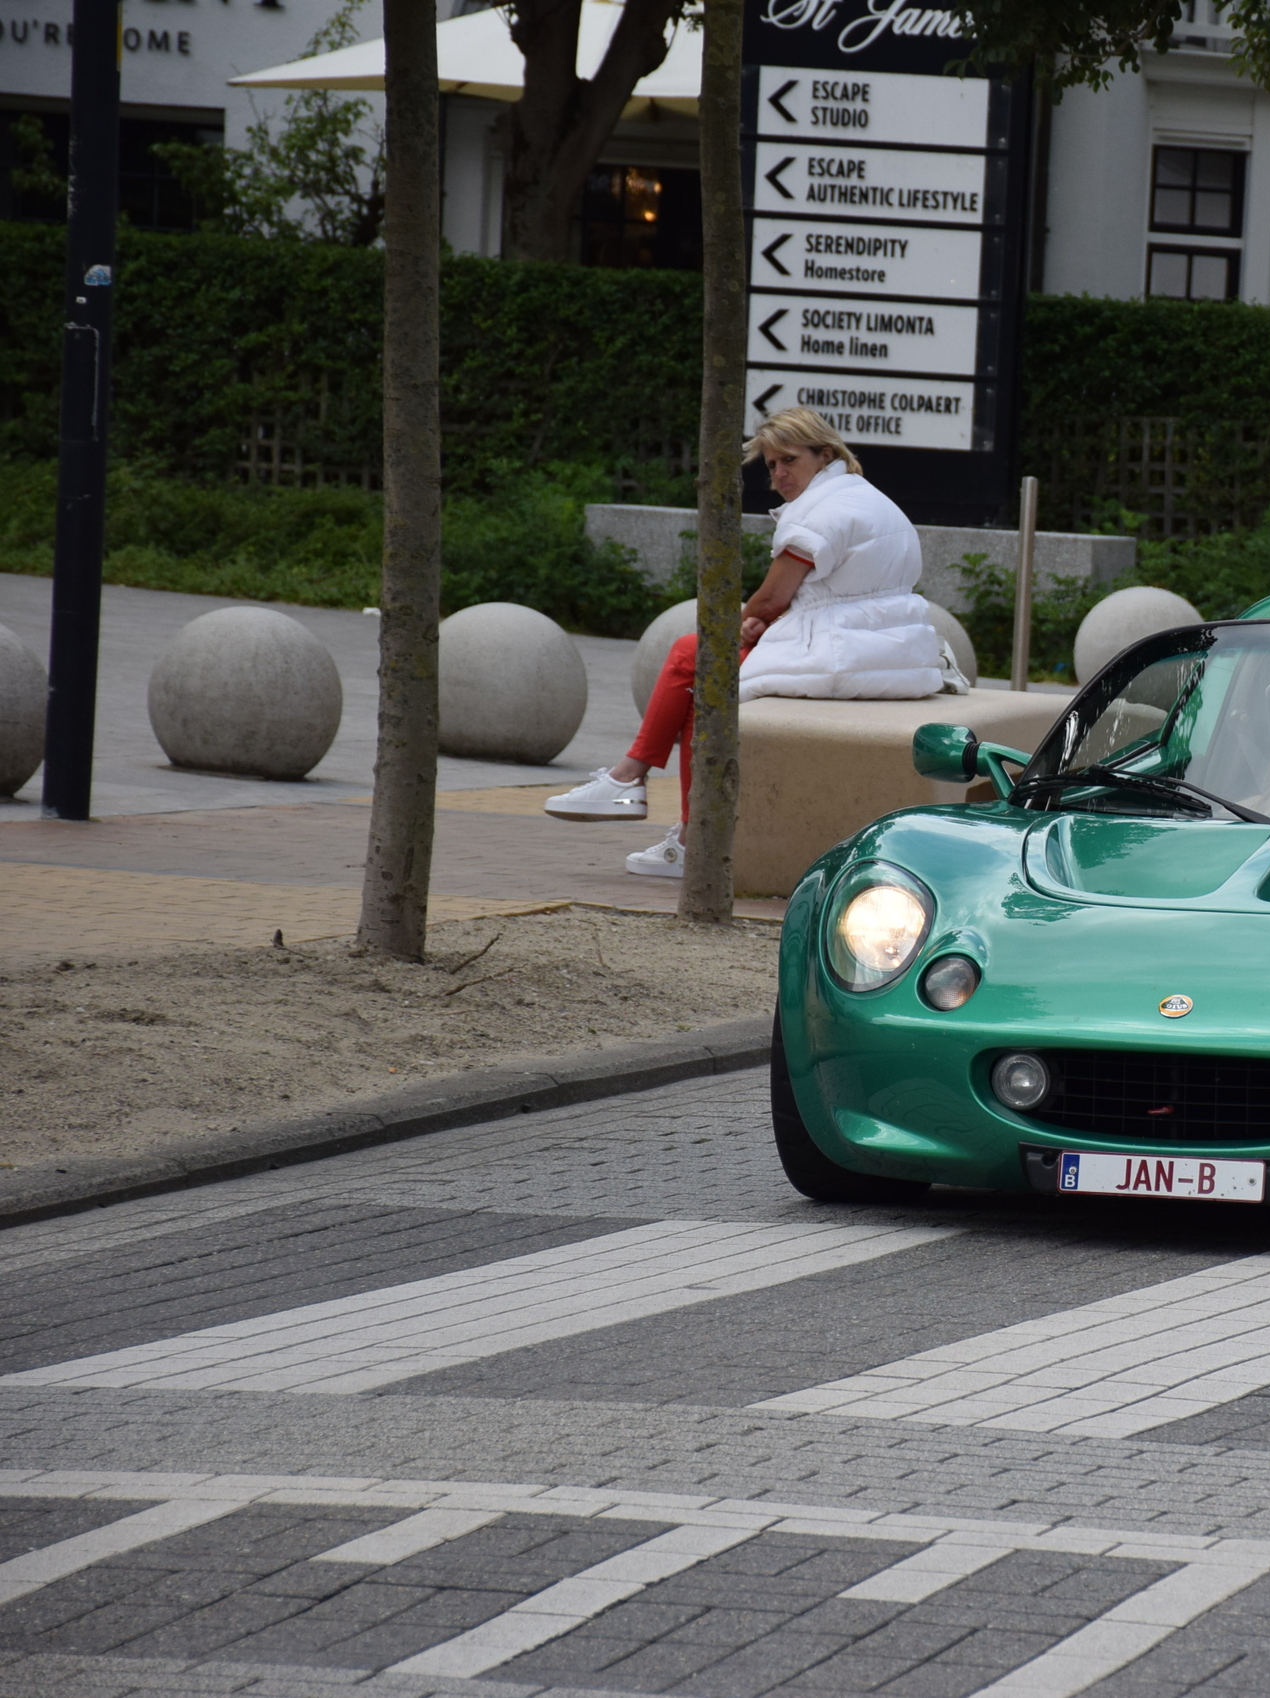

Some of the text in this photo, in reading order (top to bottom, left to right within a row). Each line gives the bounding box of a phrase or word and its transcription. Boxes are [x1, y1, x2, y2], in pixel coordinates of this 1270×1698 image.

[123, 27, 191, 55] OME
[812, 80, 870, 102] ESCAPE
[811, 106, 869, 128] STUDIO
[808, 157, 866, 179] ESCAPE
[806, 183, 978, 212] AUTHENTIC LIFESTYLE
[805, 233, 908, 258] SERENDIPITY
[804, 259, 886, 282] Homestore
[802, 308, 934, 335] SOCIETY LIMONTA
[801, 334, 888, 358] Home linen
[797, 387, 961, 414] CHRISTOPHE COLPAERT
[856, 415, 902, 435] OFFICE
[1064, 1158, 1216, 1194] B JAN-B
